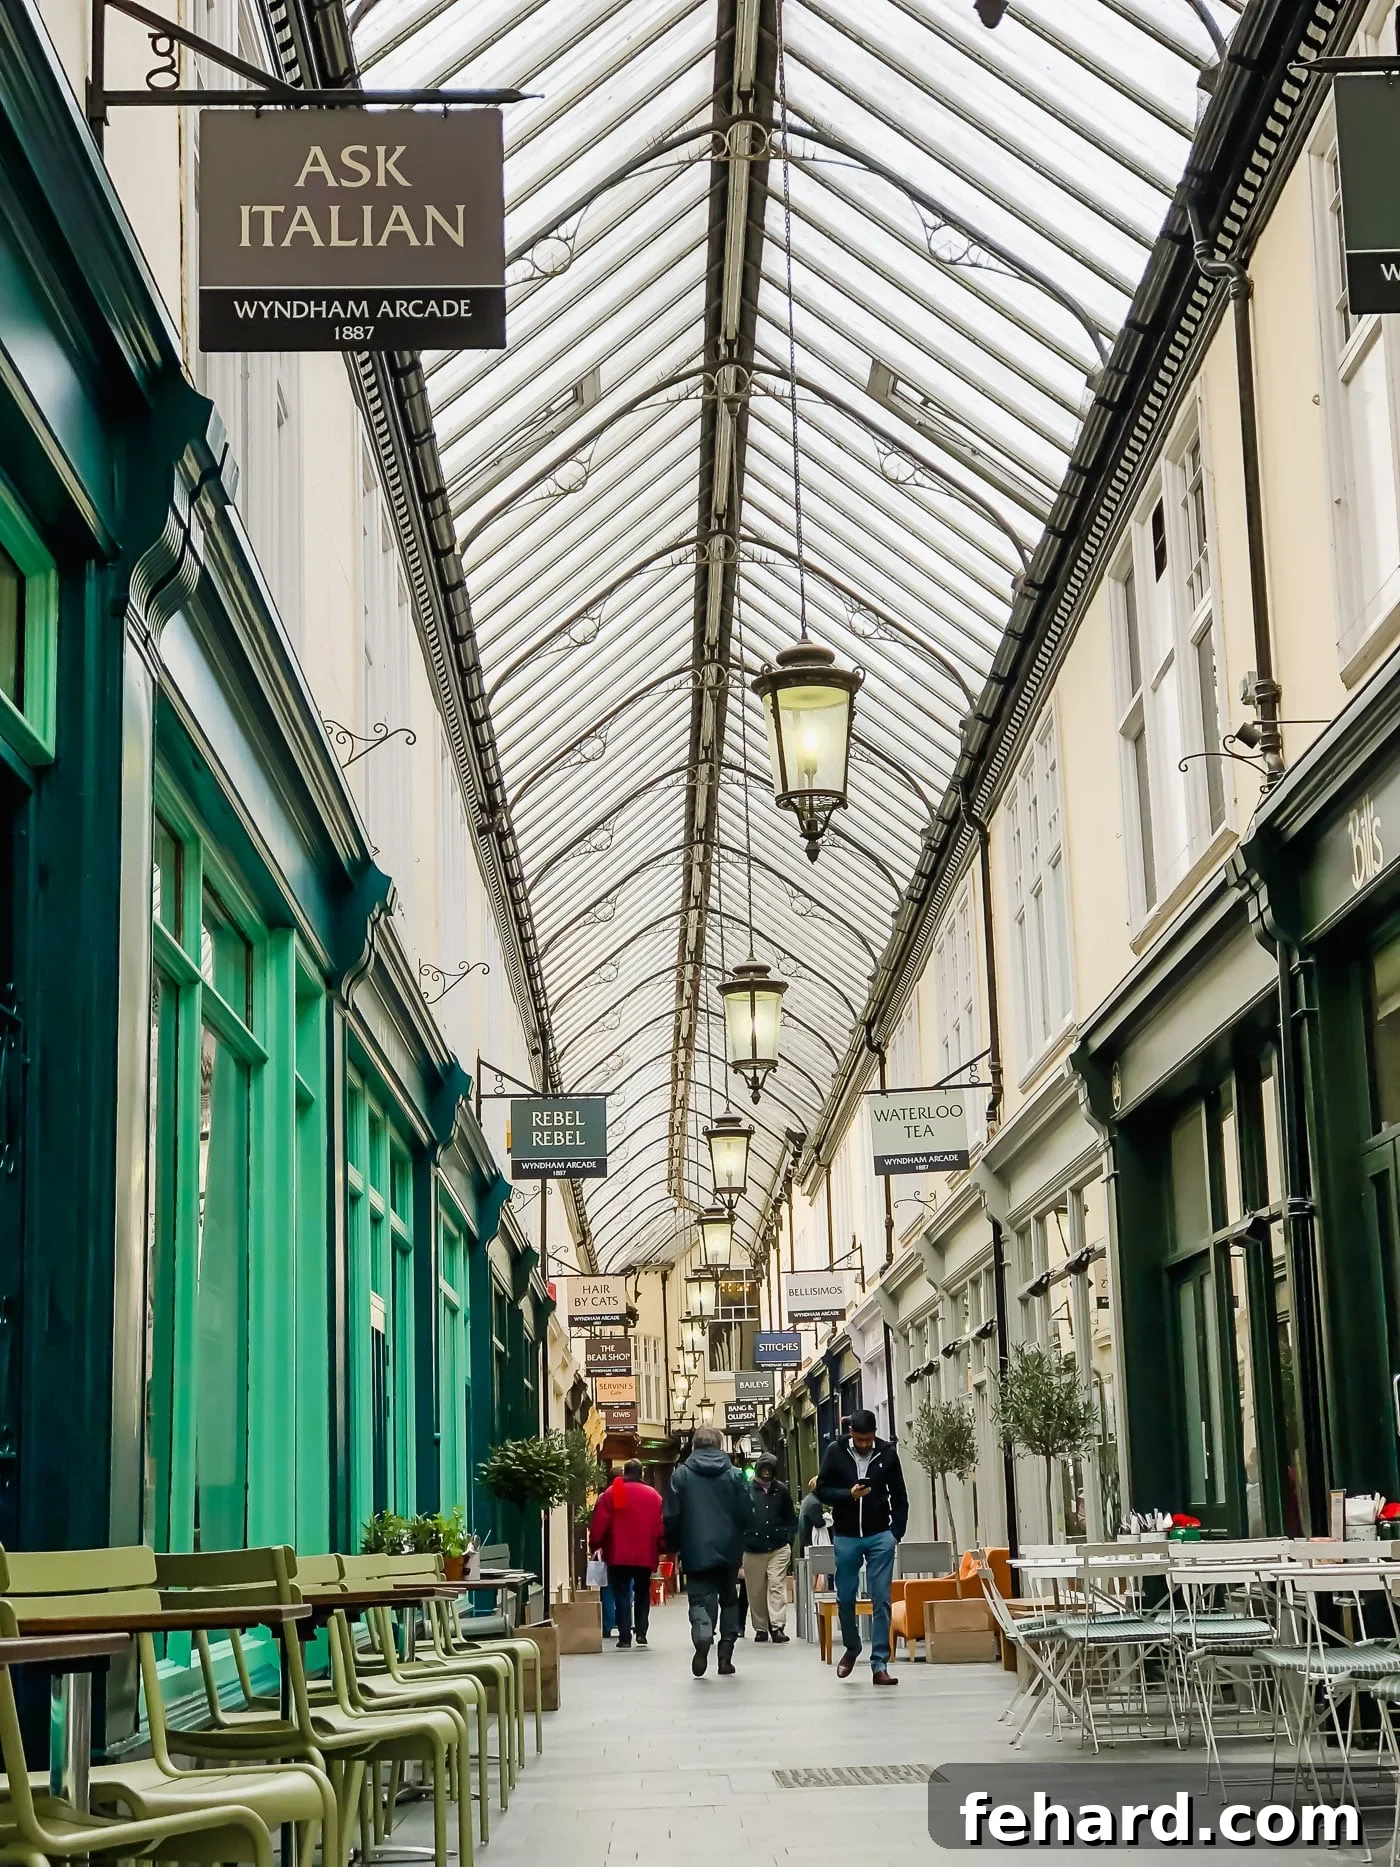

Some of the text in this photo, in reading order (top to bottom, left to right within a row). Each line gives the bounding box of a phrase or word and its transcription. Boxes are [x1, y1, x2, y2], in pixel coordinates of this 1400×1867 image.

[293, 144, 412, 188] ASK
[239, 204, 466, 247] ITALIAN
[233, 299, 473, 319] WYNDHAM ARCADE
[334, 325, 375, 340] 1887
[531, 1110, 586, 1126] REBEL
[873, 1104, 963, 1122] WATERLOO
[903, 1124, 935, 1138] TEA
[532, 1130, 586, 1146] REBEL
[521, 1161, 597, 1170] WYNDHAM ARCADE
[883, 1154, 959, 1166] WYNDHAM ARCADE
[582, 1284, 611, 1294] HAIR
[788, 1286, 843, 1297] BELLISIMOS
[574, 1296, 619, 1307] BY CATS
[600, 1344, 616, 1353] THE
[758, 1342, 799, 1352] STITCHES
[586, 1352, 631, 1362] BEAR SHOP
[739, 1380, 770, 1389] BAILEYS
[728, 1404, 747, 1412] BANG
